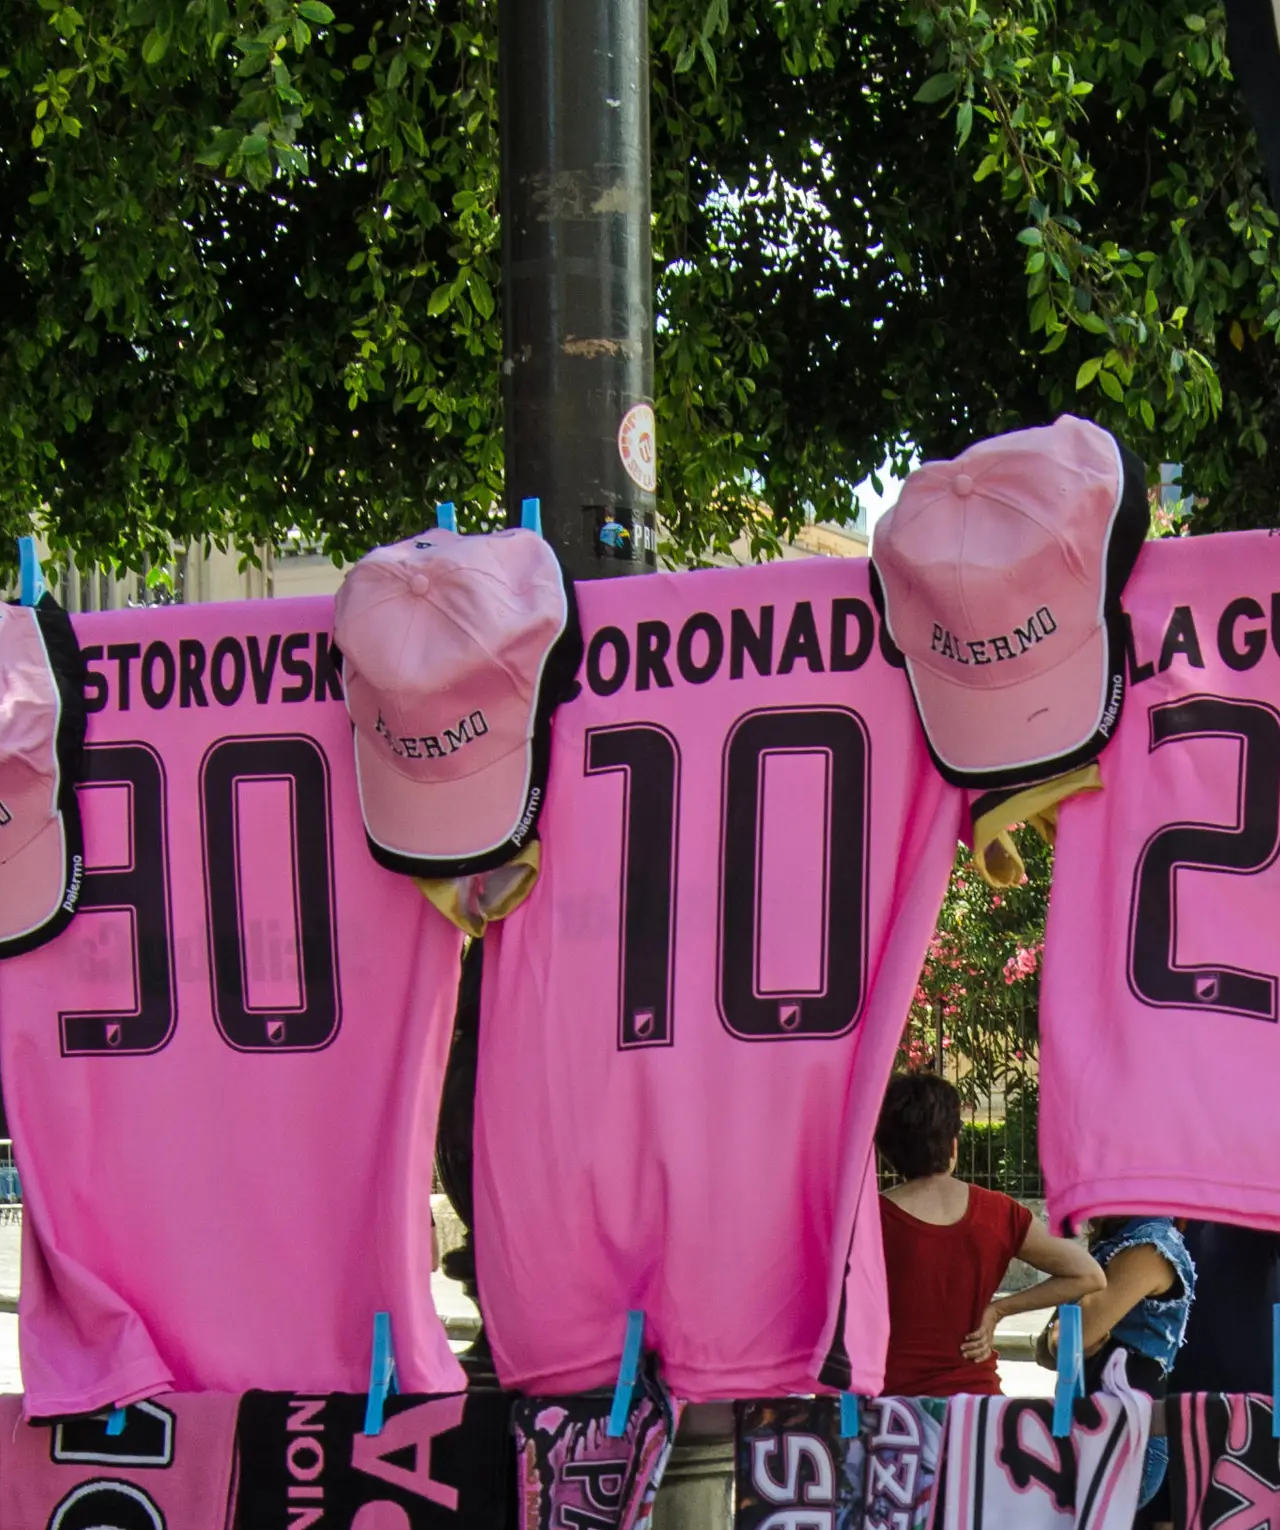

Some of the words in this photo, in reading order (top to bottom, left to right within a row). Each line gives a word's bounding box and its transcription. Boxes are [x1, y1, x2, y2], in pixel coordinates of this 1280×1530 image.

[578, 597, 905, 698] ORONAD
[931, 606, 1057, 665] PALERMO
[1123, 606, 1204, 686] LA
[375, 707, 489, 760] PLERMO
[1099, 675, 1122, 737] palermo
[511, 787, 541, 847] palermo
[62, 854, 83, 913] palermo
[584, 703, 872, 1052] 10
